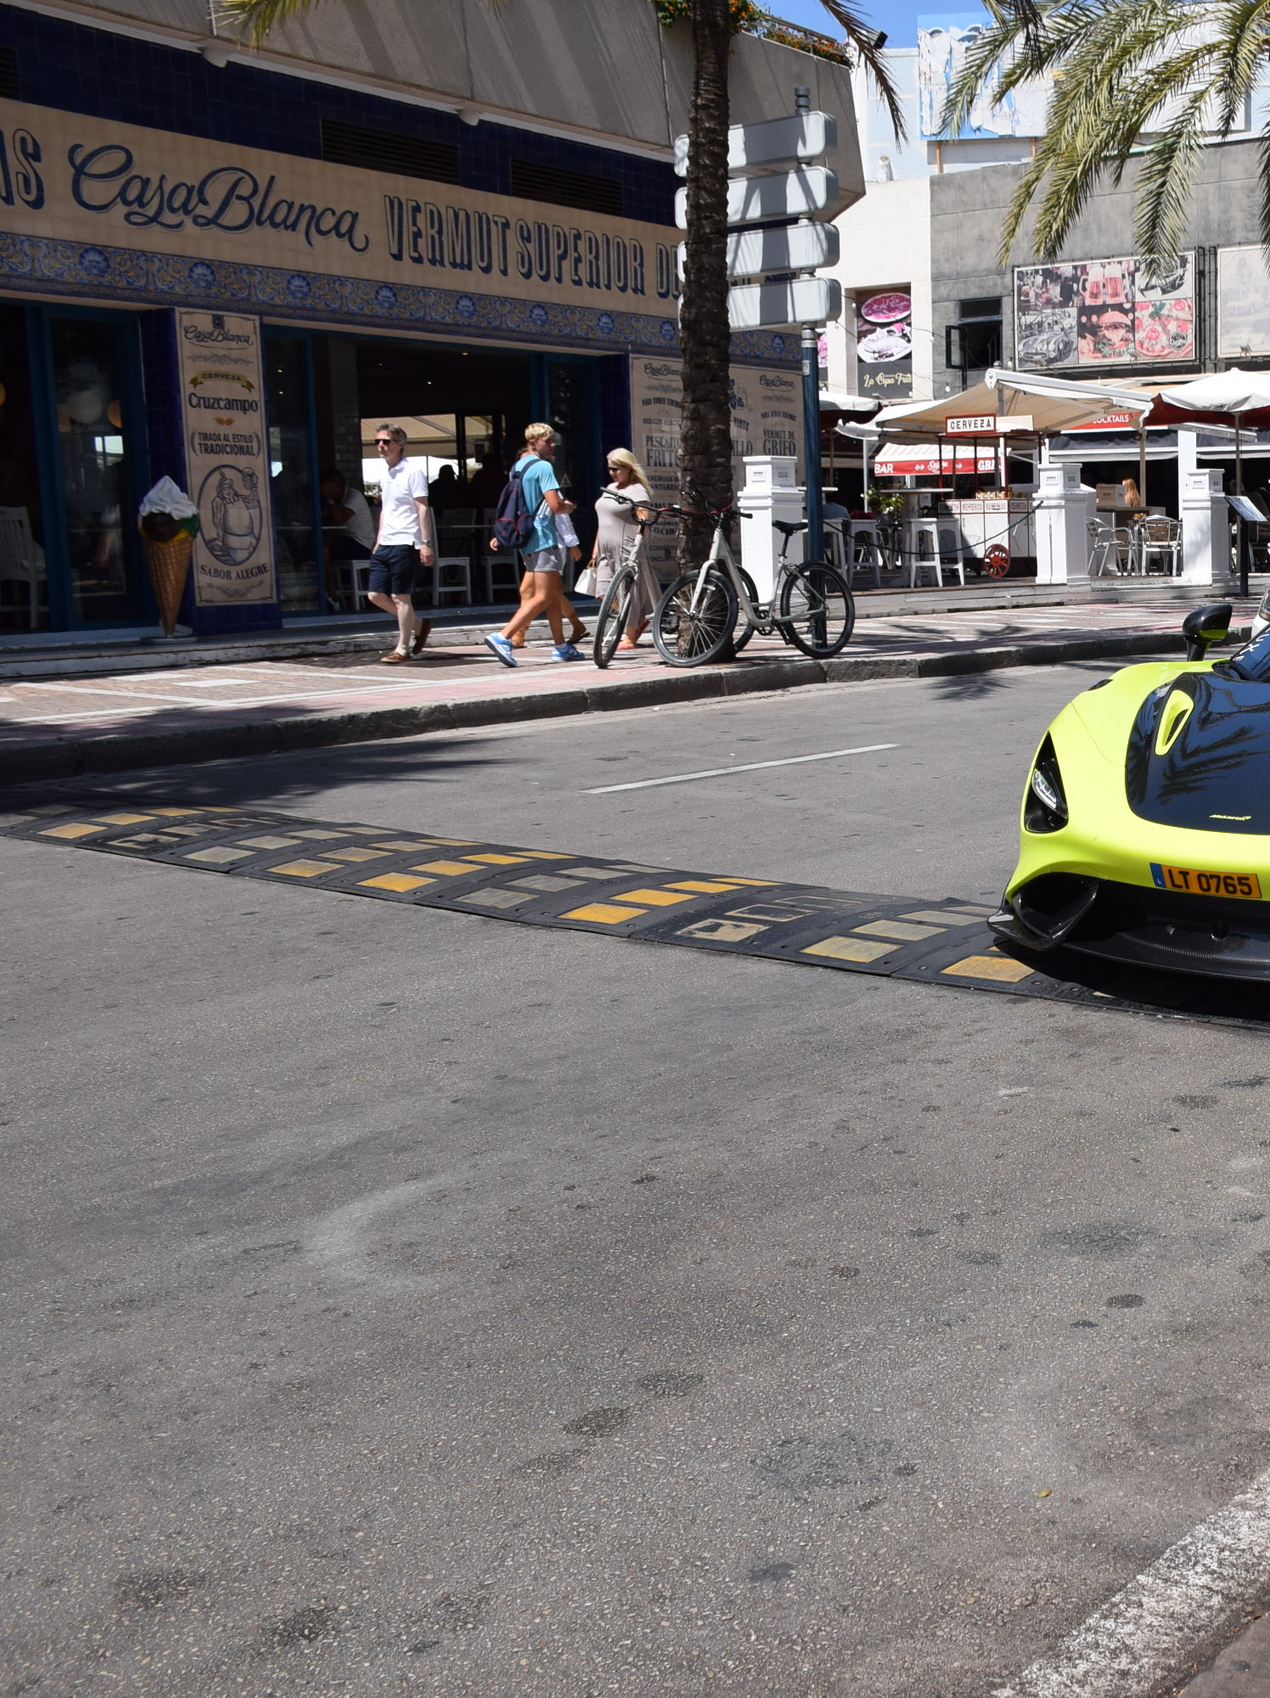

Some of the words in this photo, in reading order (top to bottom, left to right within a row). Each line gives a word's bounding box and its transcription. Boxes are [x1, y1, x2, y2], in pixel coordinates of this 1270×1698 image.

[384, 194, 511, 277] VERMUT
[515, 218, 647, 296] SUPERIOR
[201, 372, 242, 383] CERVEZA
[188, 392, 259, 415] Cruzcampo
[950, 418, 992, 431] CERVEZA
[1092, 414, 1129, 424] OCKTAILS
[198, 432, 222, 442] TIRADA
[223, 434, 231, 443] AL
[232, 434, 254, 444] ESTILO
[198, 442, 256, 457] TRADICIONAL
[763, 439, 797, 457] GRIFO
[875, 463, 894, 475] BAR
[200, 564, 233, 581] SABOR
[235, 562, 270, 581] ALEGRE
[1167, 868, 1190, 891] LT
[1196, 872, 1253, 896] 0765
